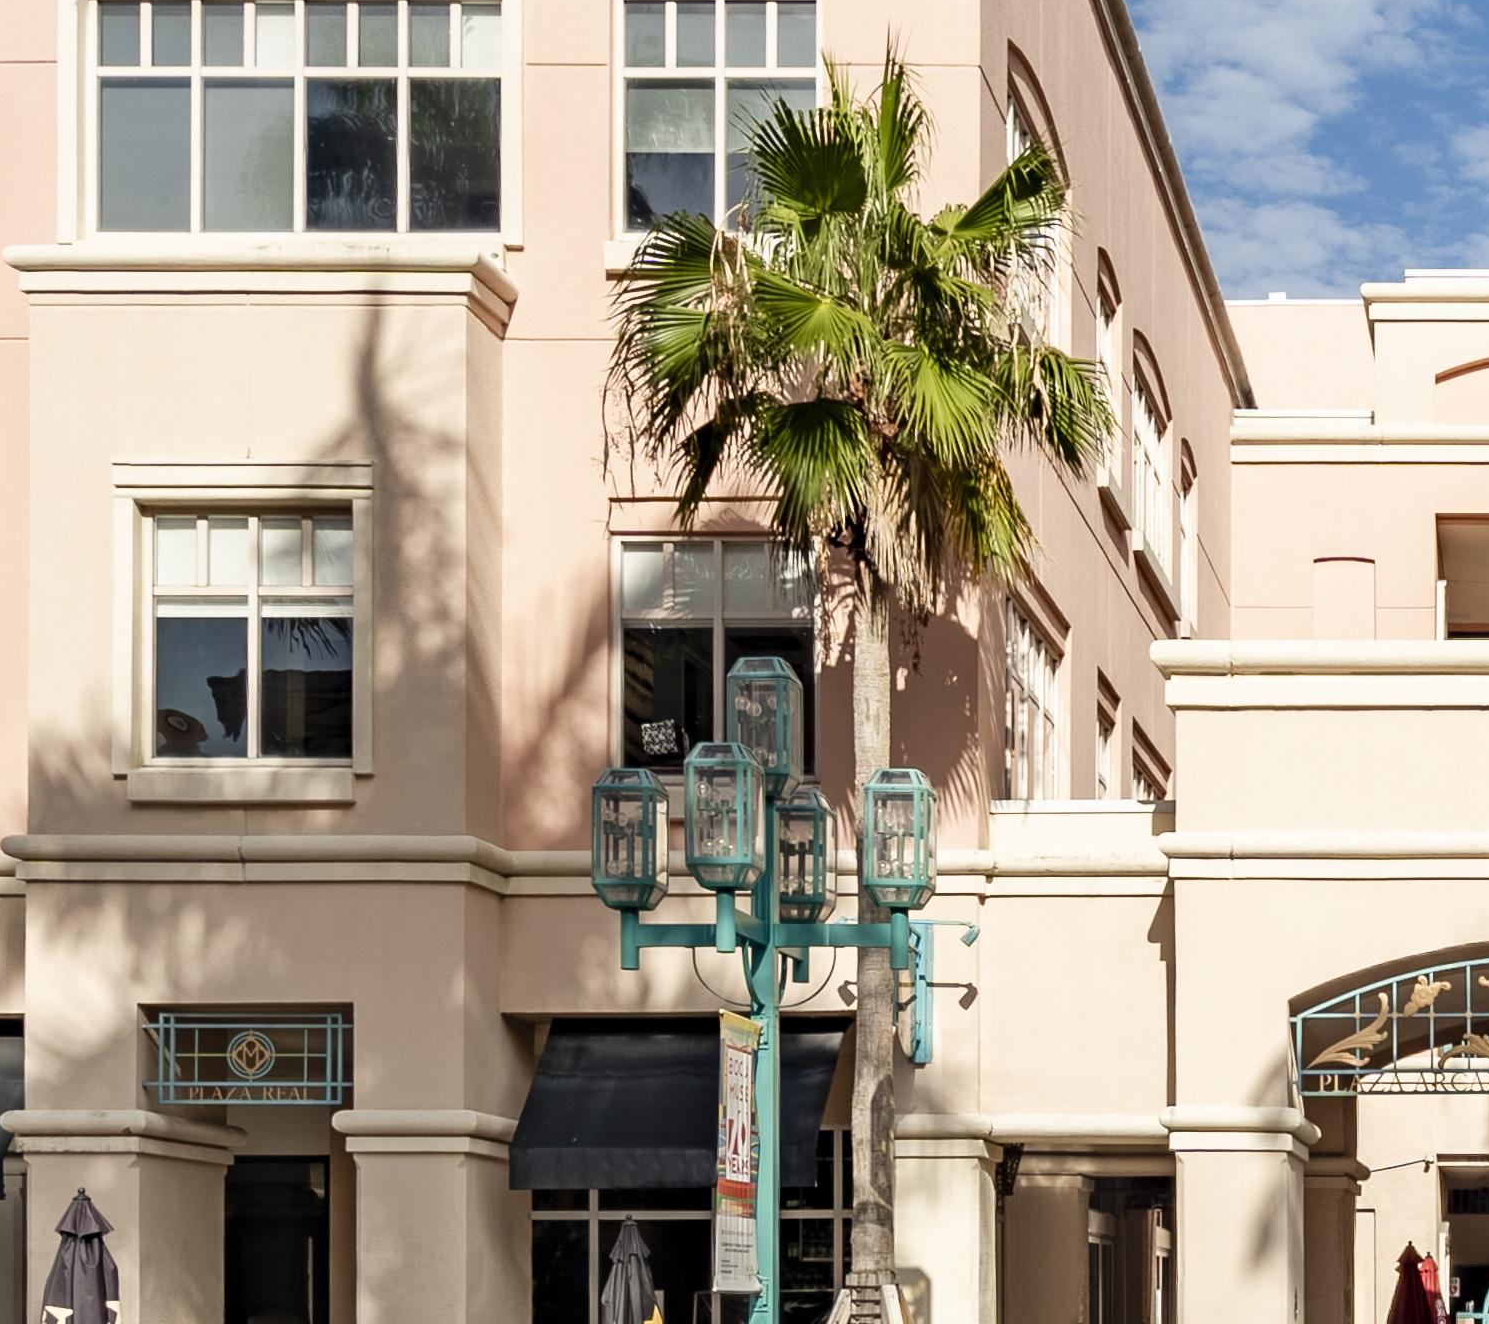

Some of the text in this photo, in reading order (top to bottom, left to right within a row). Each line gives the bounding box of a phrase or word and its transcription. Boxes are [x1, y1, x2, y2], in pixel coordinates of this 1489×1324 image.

[1319, 1072, 1404, 1092] PLAZA
[189, 1086, 314, 1101] PLAZA REAL
